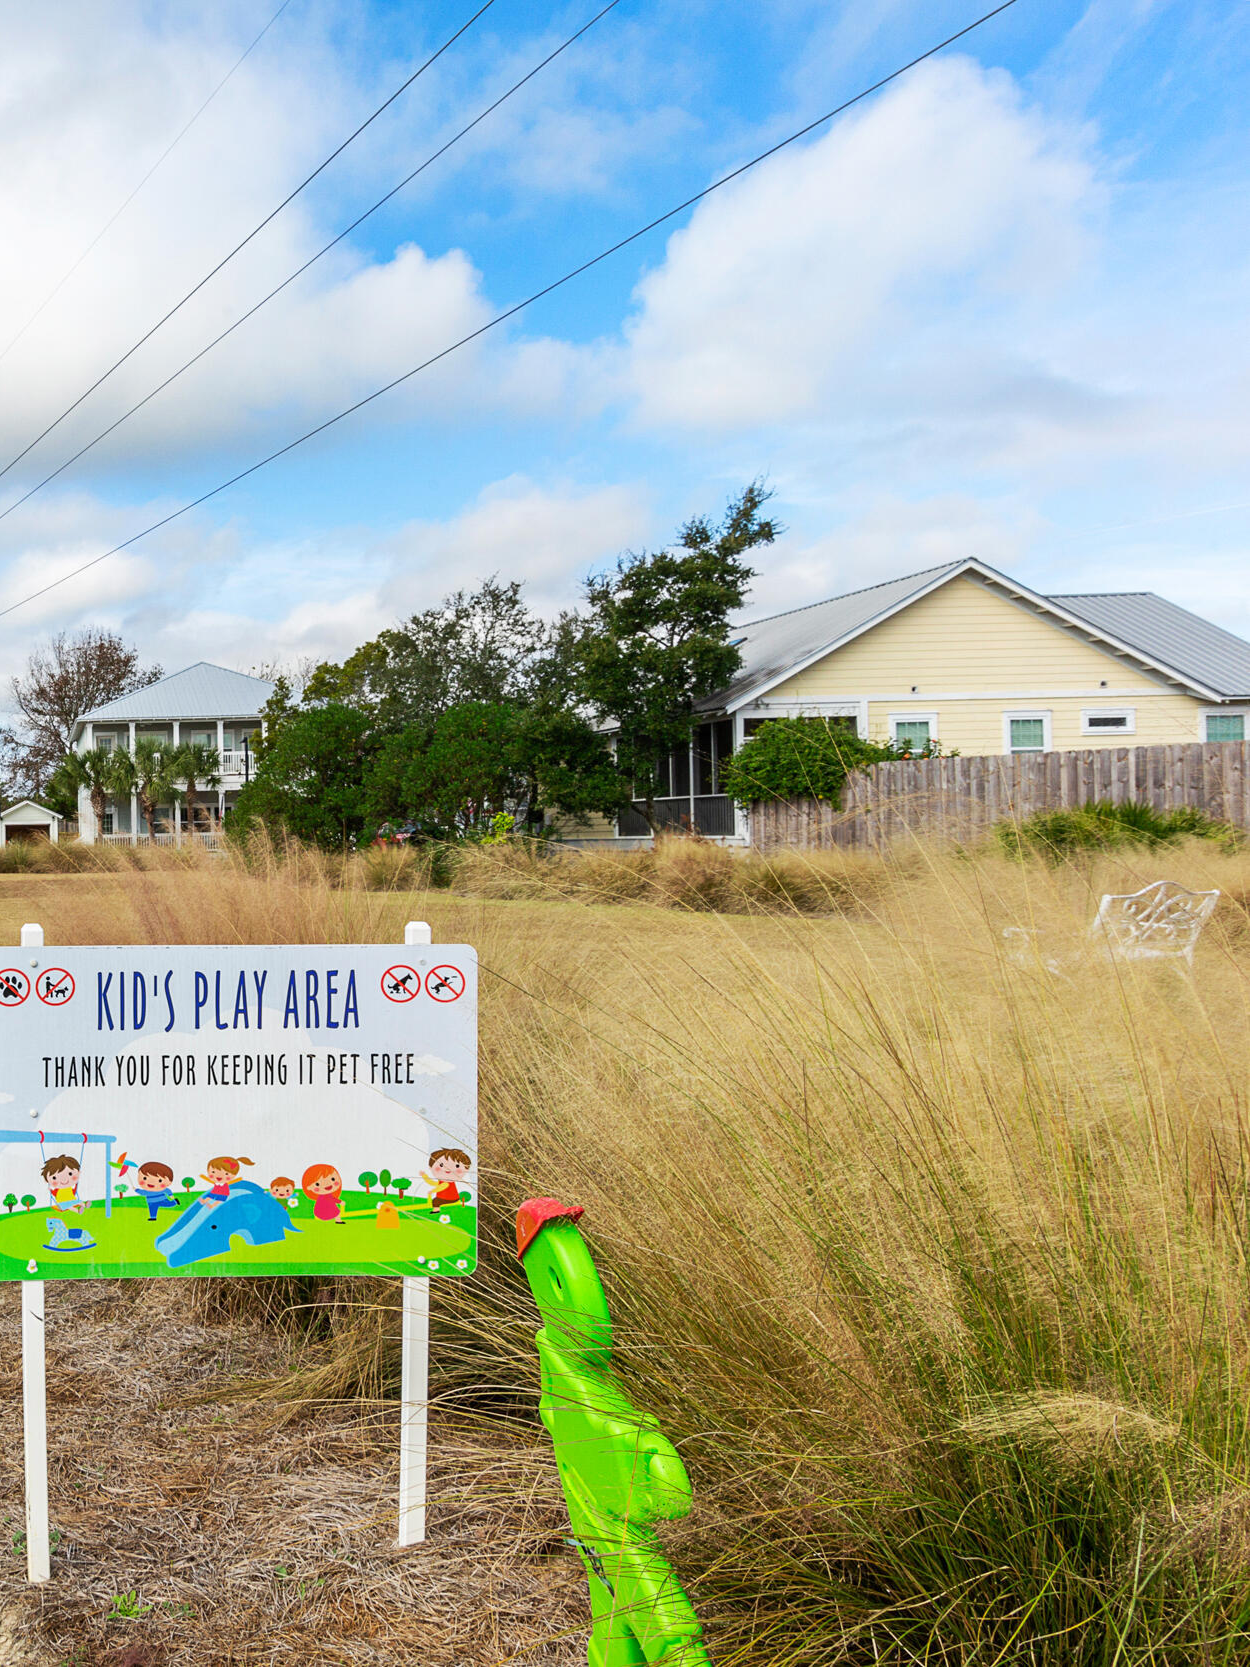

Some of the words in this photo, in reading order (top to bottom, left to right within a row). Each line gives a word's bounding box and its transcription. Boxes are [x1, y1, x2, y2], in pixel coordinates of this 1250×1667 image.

[96, 969, 176, 1033] KID'S
[193, 968, 269, 1031] PLAY
[283, 968, 361, 1030] AREA
[42, 1055, 106, 1088] THANK
[115, 1055, 150, 1087] YOU
[161, 1054, 196, 1086] FOR
[207, 1053, 288, 1086] KEEPING
[299, 1053, 316, 1085] IT
[327, 1053, 360, 1085] PET
[370, 1052, 416, 1085] FREE
